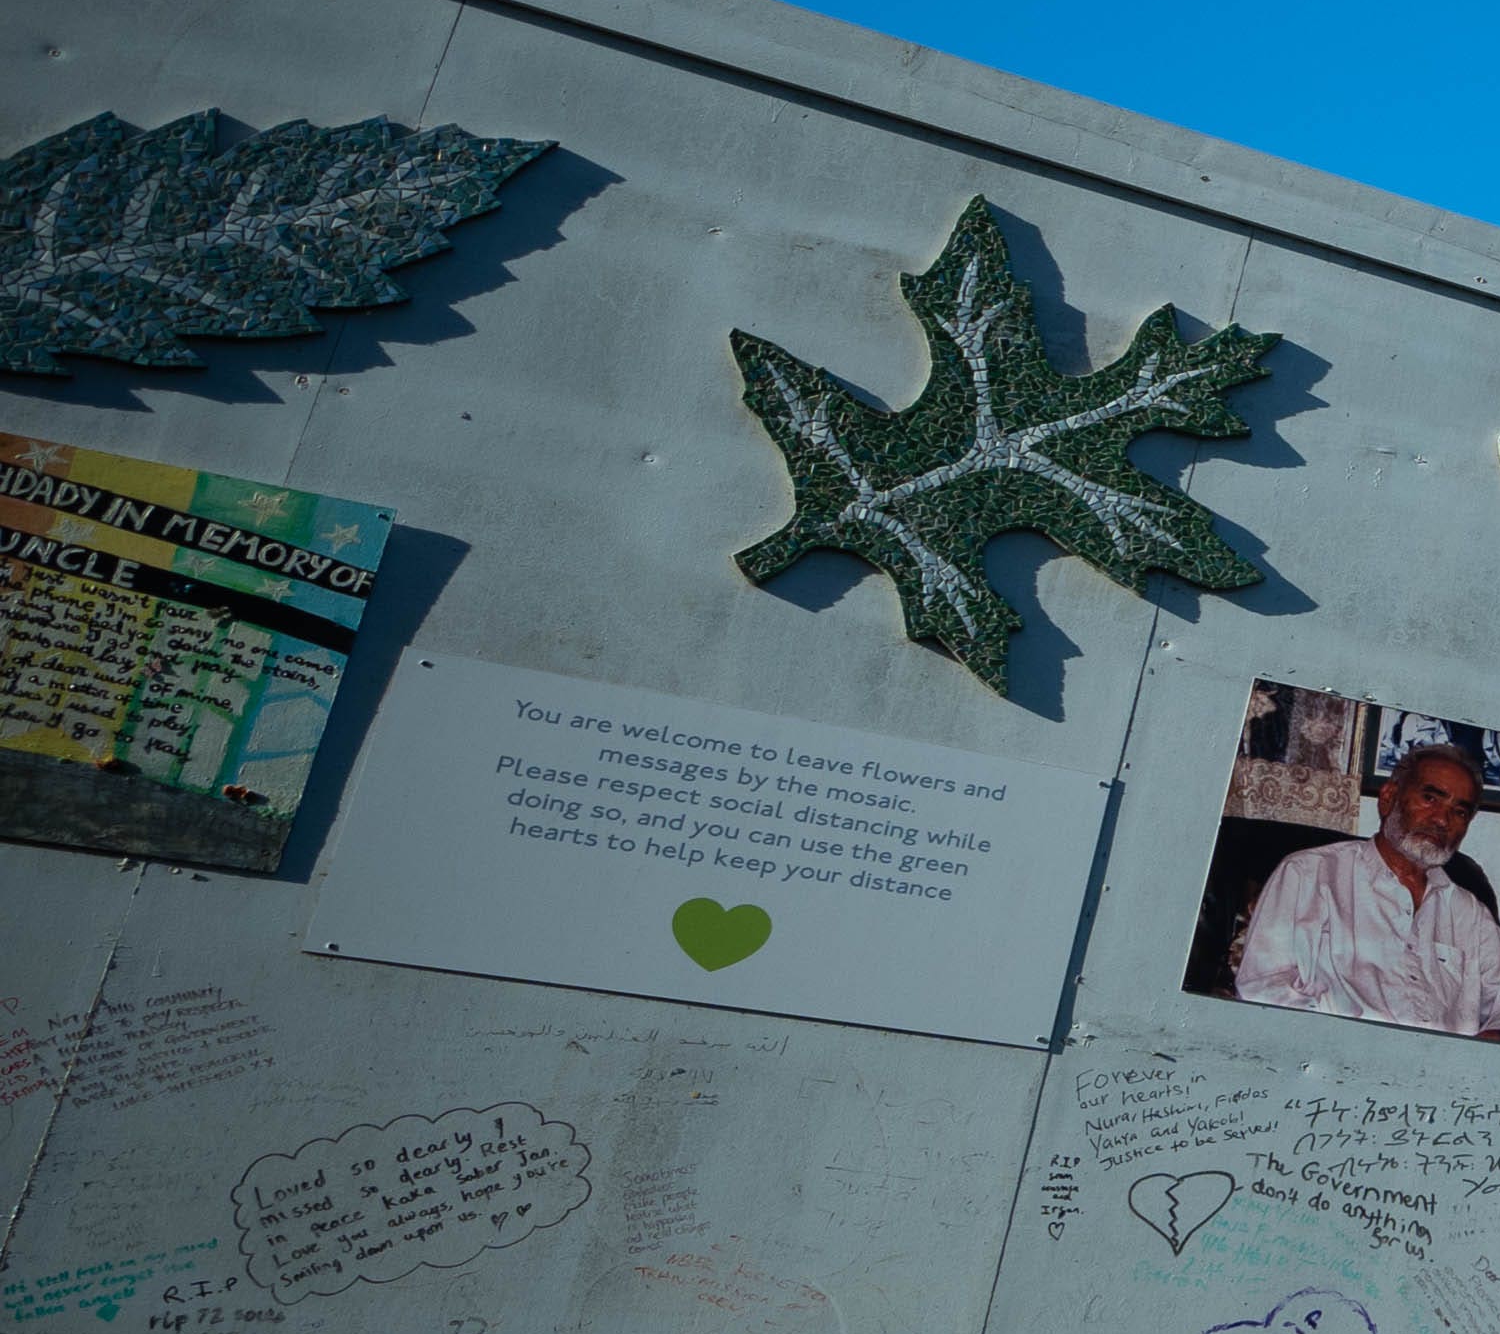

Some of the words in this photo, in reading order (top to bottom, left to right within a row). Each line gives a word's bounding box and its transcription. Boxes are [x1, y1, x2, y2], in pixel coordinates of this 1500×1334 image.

[102, 498, 155, 531] IN
[163, 514, 330, 579] MEMORY
[81, 584, 148, 607] wasn't
[516, 700, 560, 724] You
[570, 715, 612, 733] are
[622, 723, 742, 757] welcome
[751, 743, 777, 762] to
[786, 747, 853, 776] leave
[862, 761, 956, 793] flowers
[964, 783, 1007, 802] and
[599, 749, 727, 782] messages
[738, 767, 768, 792] by
[776, 776, 818, 797] the
[827, 786, 916, 814] mosaic.
[496, 756, 588, 789] Please
[598, 774, 700, 806] respect
[710, 792, 783, 819] social
[794, 806, 918, 844] distancing
[927, 829, 992, 853] while
[507, 789, 581, 821] doing
[591, 804, 626, 825] so,
[637, 812, 685, 832] and
[692, 823, 739, 841] you
[748, 830, 792, 849] can
[801, 839, 844, 857] use
[851, 844, 892, 864] the
[901, 855, 968, 878] green
[510, 817, 598, 848] hearts
[607, 835, 636, 853] to
[645, 838, 704, 866] help
[713, 850, 776, 878] keep
[783, 862, 842, 883] your
[850, 872, 952, 901] distance
[1076, 1069, 1175, 1101] Forever
[1191, 1071, 1207, 1083] in
[1080, 1094, 1107, 1109] our
[1122, 1086, 1190, 1106] hearts!
[1151, 1125, 1178, 1137] and
[1171, 1138, 1188, 1152] to
[1196, 1132, 1216, 1146] be
[255, 1170, 326, 1210] Loved
[352, 1160, 376, 1176] so
[397, 1131, 472, 1164] dearly
[361, 1185, 378, 1198] so
[1246, 1152, 1294, 1176] The
[1301, 1162, 1438, 1215] Government
[268, 1233, 287, 1247] in
[311, 1211, 365, 1234] peace
[273, 1243, 319, 1269] Love
[338, 1230, 368, 1254] you
[461, 1181, 504, 1203] hope
[1251, 1179, 1297, 1205] don't
[1308, 1193, 1329, 1211] do
[1342, 1202, 1433, 1245] anything
[197, 1307, 224, 1324] 72
